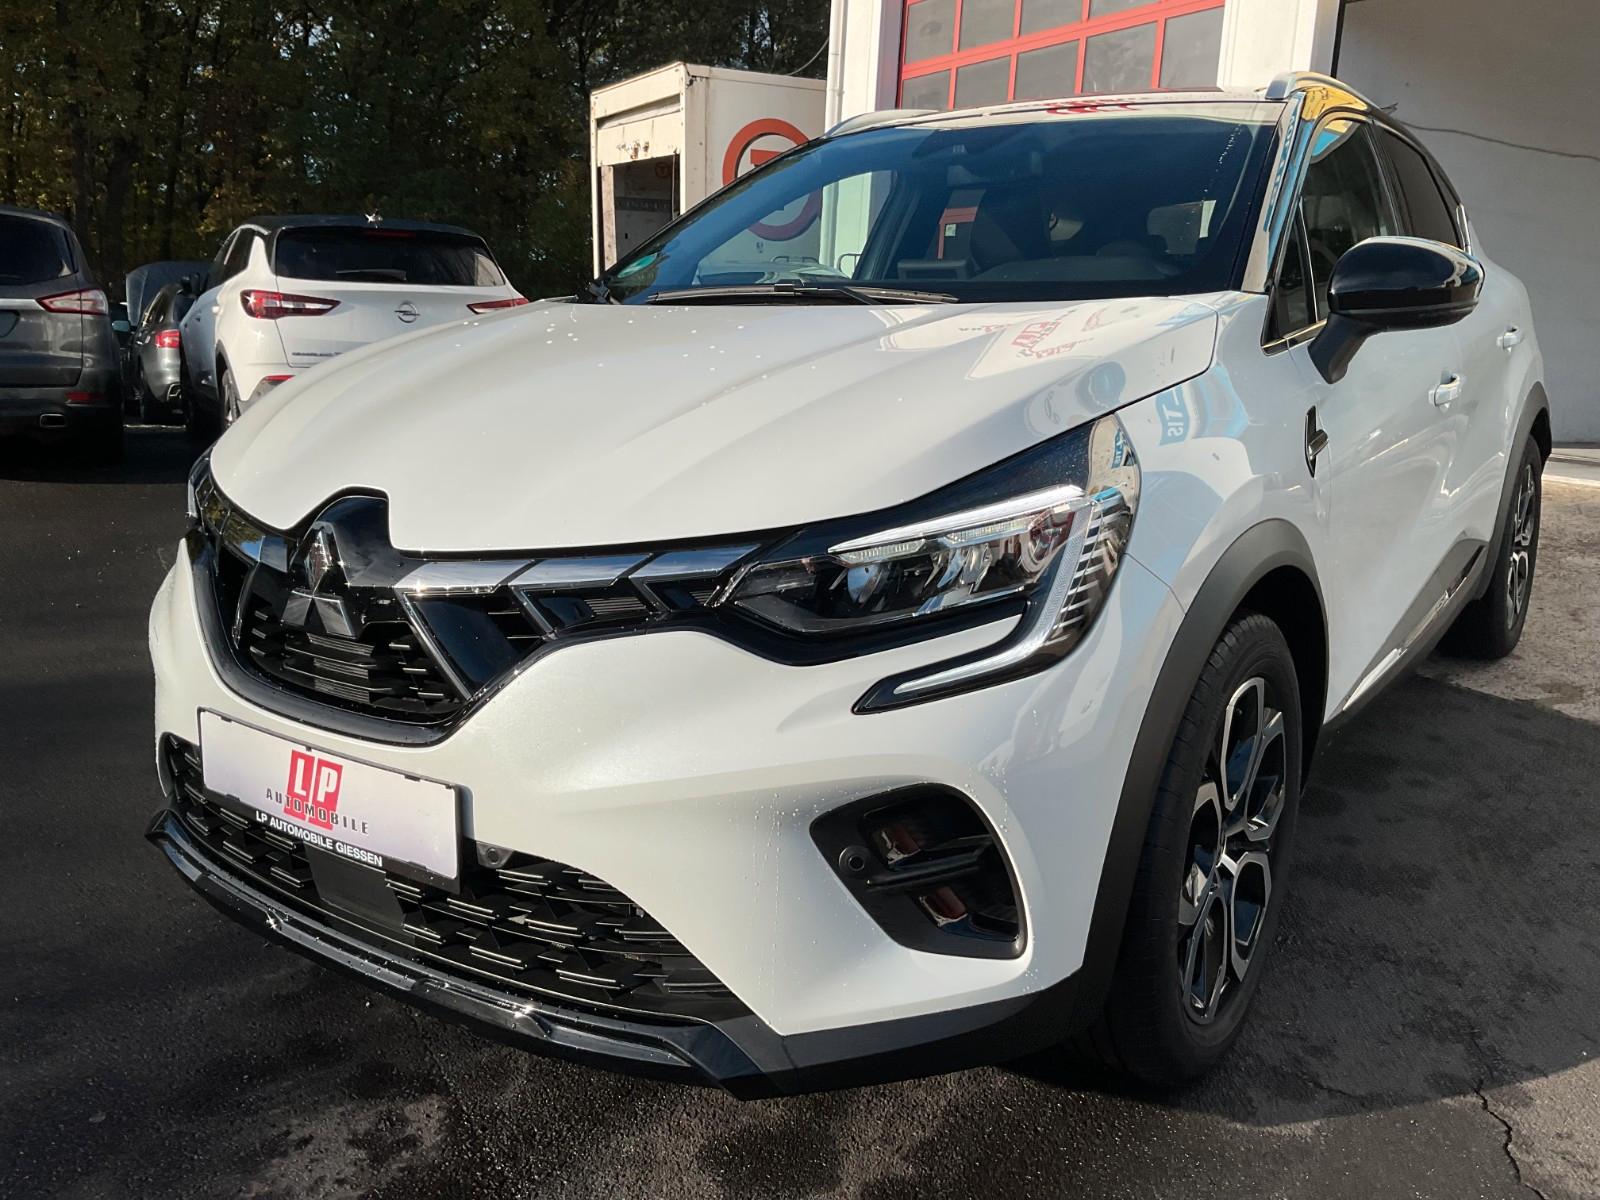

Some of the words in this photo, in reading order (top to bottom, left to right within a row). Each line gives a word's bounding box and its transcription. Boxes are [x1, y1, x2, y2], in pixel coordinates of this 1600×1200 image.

[293, 757, 339, 804] LP
[266, 788, 369, 835] AUTOMOBILE
[255, 810, 268, 823] LP
[270, 817, 334, 849] AUTOMOBILE
[335, 841, 383, 867] GIESSEN
